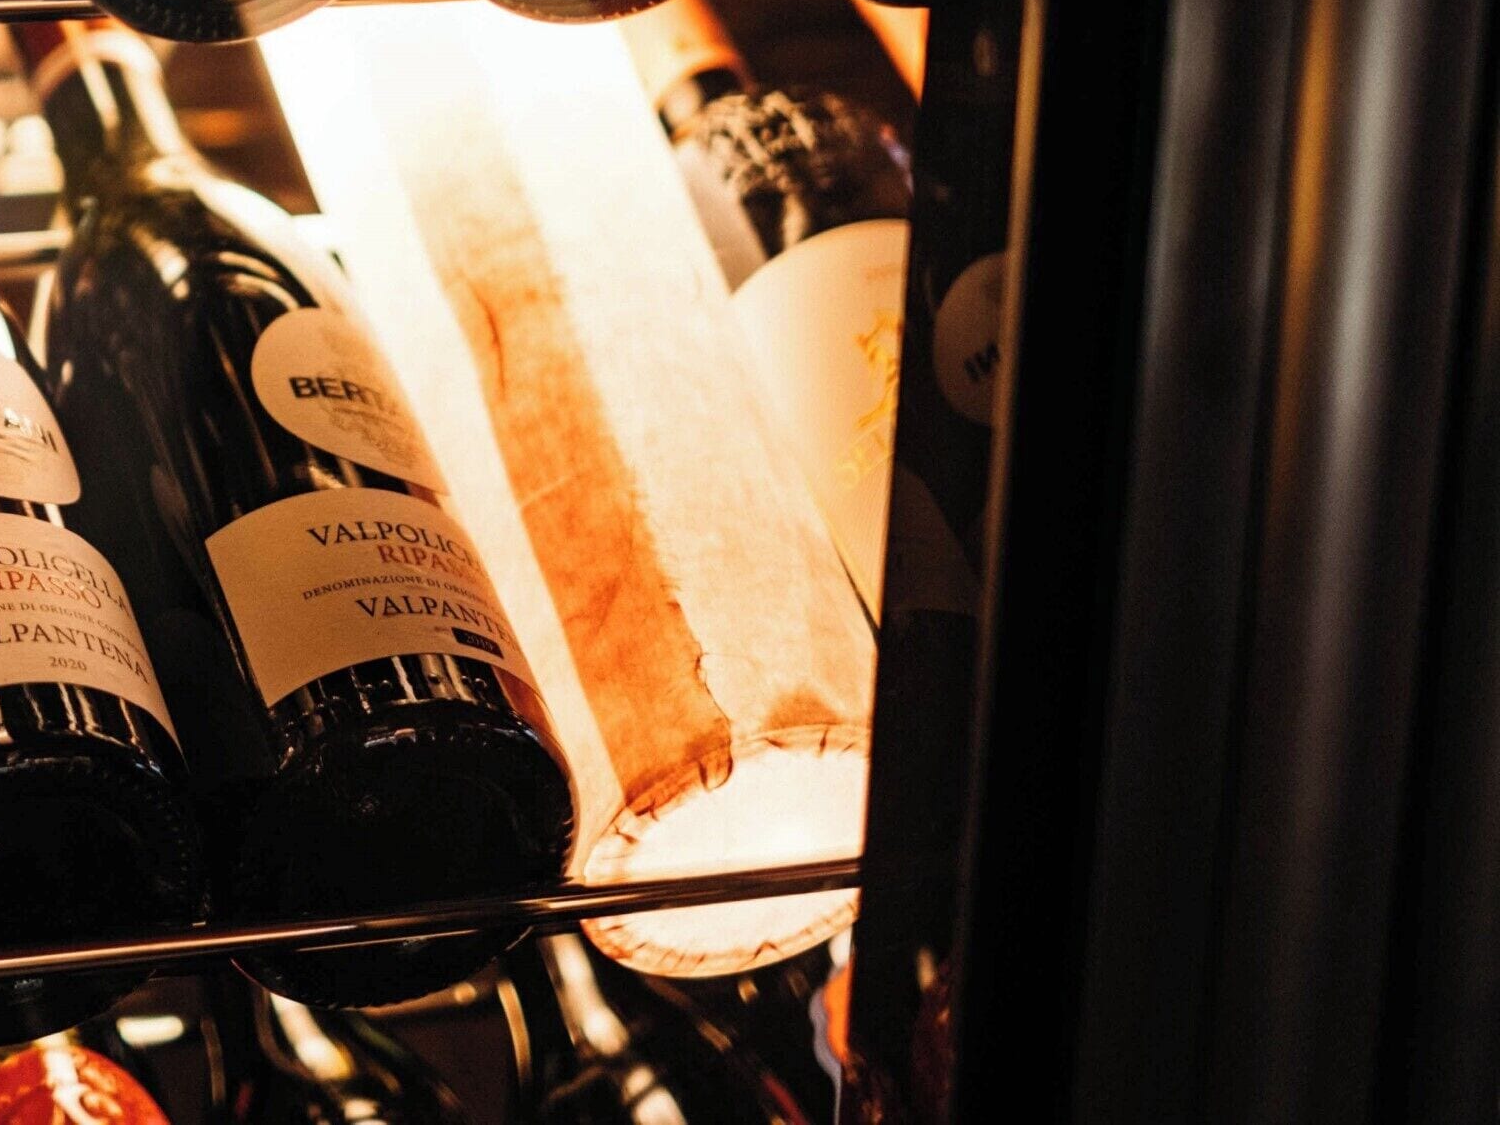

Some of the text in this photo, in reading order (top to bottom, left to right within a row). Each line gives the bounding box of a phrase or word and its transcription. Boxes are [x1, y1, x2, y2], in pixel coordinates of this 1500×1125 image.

[303, 574, 424, 600] DENOMINAZIONE
[426, 578, 442, 588] DI
[19, 602, 37, 611] DI
[39, 603, 95, 624] ORIGINE
[48, 655, 87, 671] 2020
